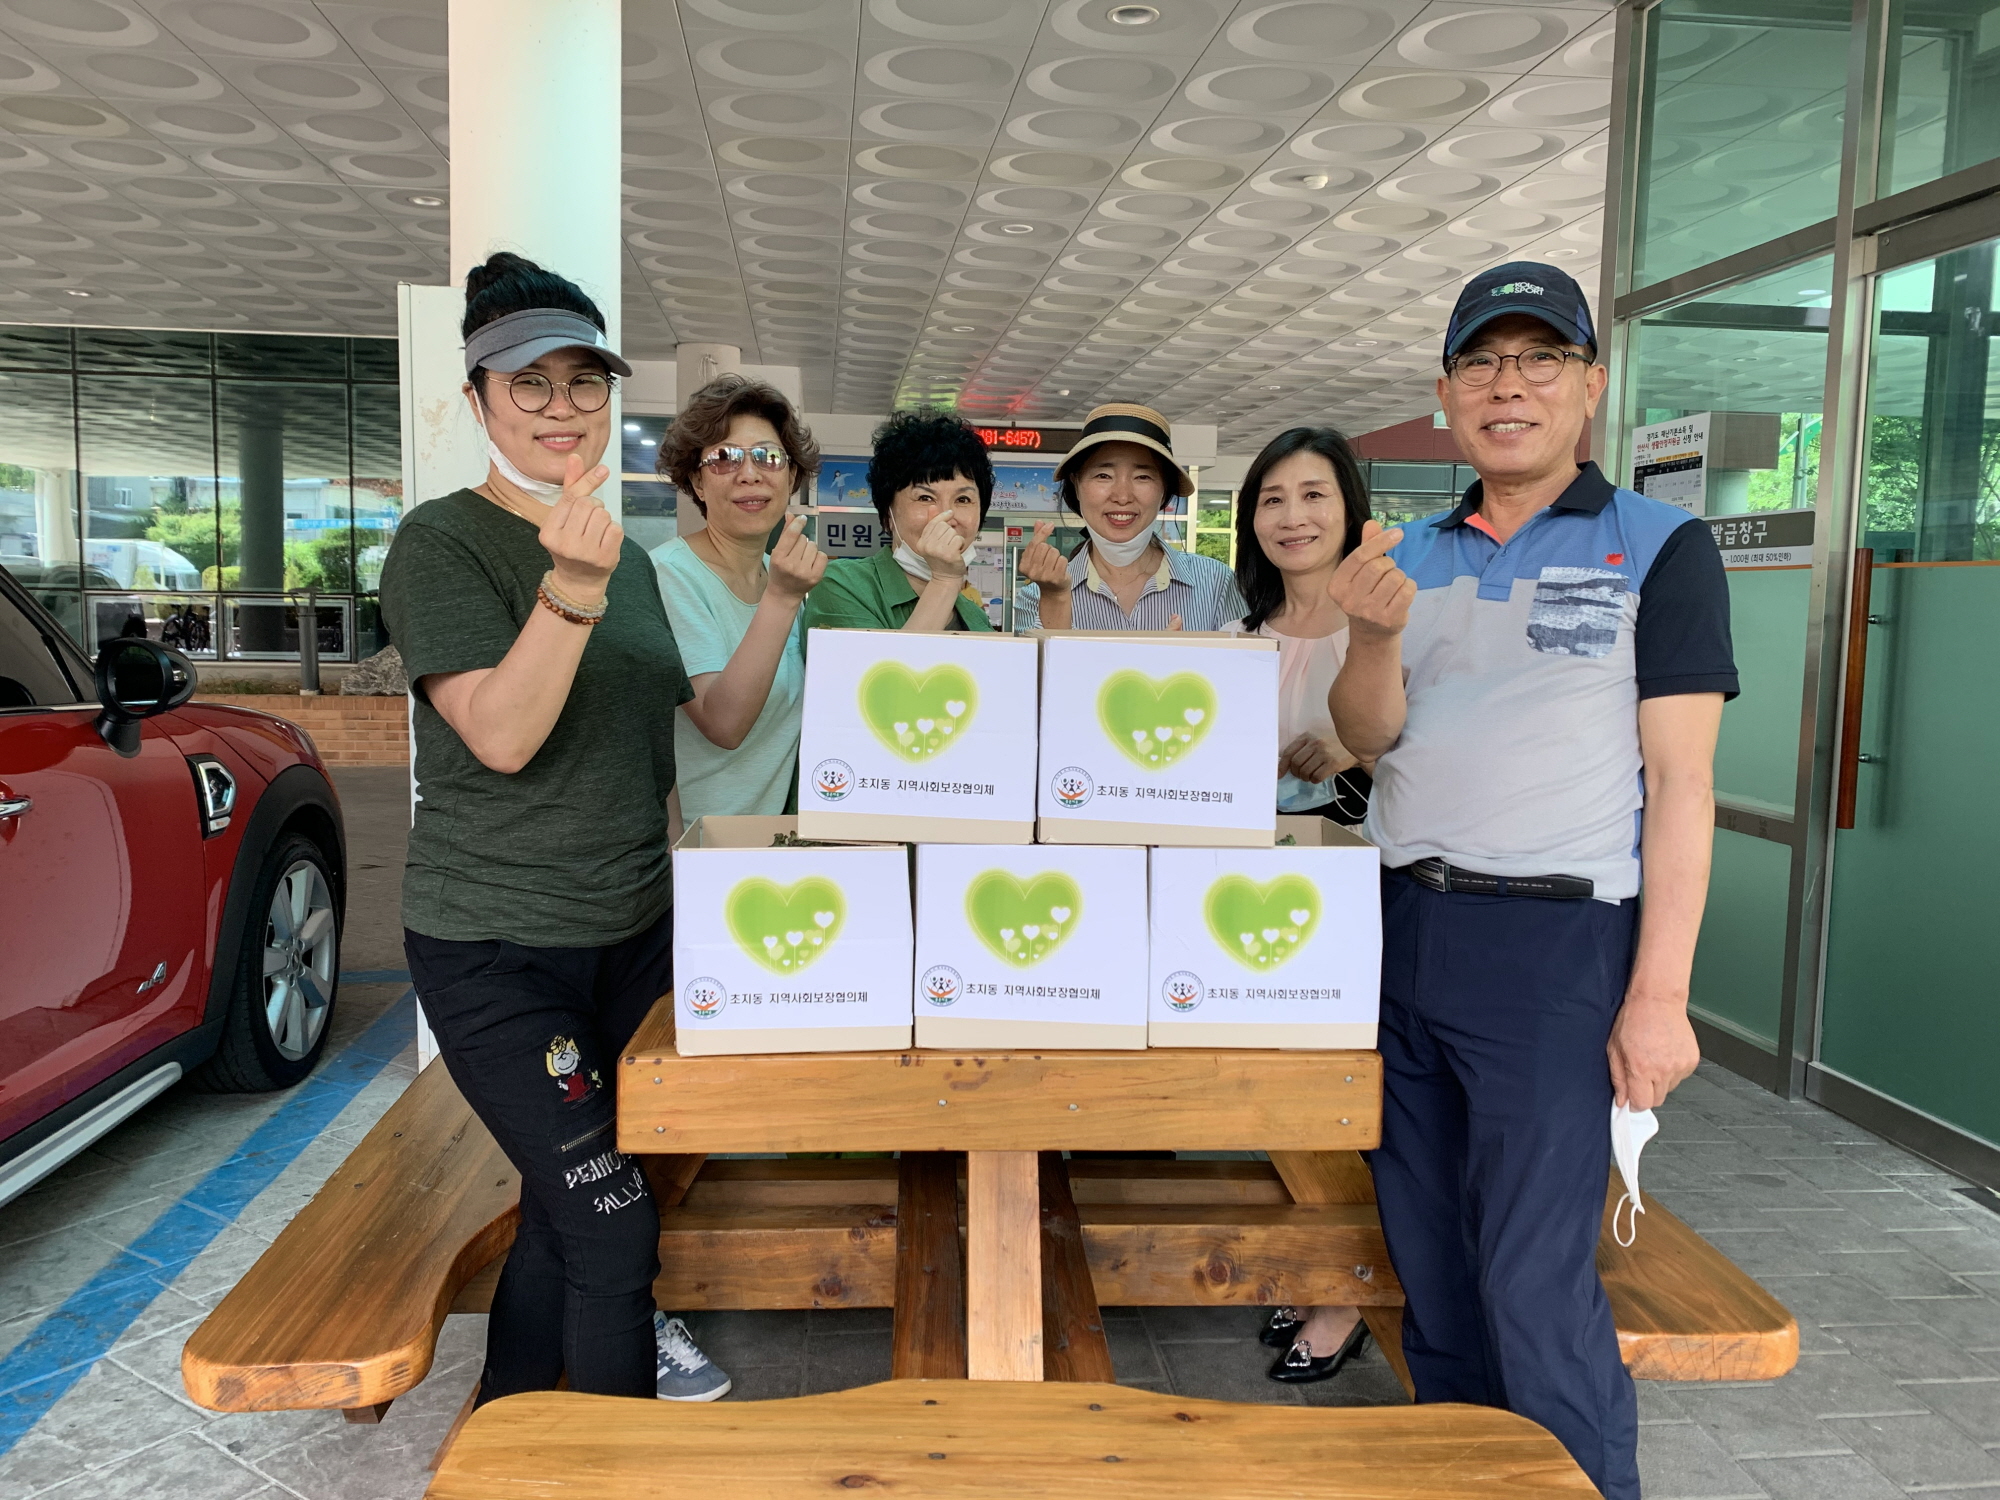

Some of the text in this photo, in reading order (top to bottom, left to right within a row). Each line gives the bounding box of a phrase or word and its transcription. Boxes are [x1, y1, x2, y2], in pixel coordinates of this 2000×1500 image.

[1514, 286, 1544, 295] SPORT
[1694, 432, 1704, 442] 안내
[1711, 520, 1768, 546] 발급창구
[858, 777, 994, 796] 초지동 지역사회보장협의체
[1096, 785, 1233, 804] 초지동 지역사회보장협의체
[729, 991, 868, 1005] 초지동 지역사회보장협의체
[966, 983, 1101, 1000] 초지동 지역사회보장협의체
[1207, 988, 1341, 1000] 초지동 지역사회보장협의체
